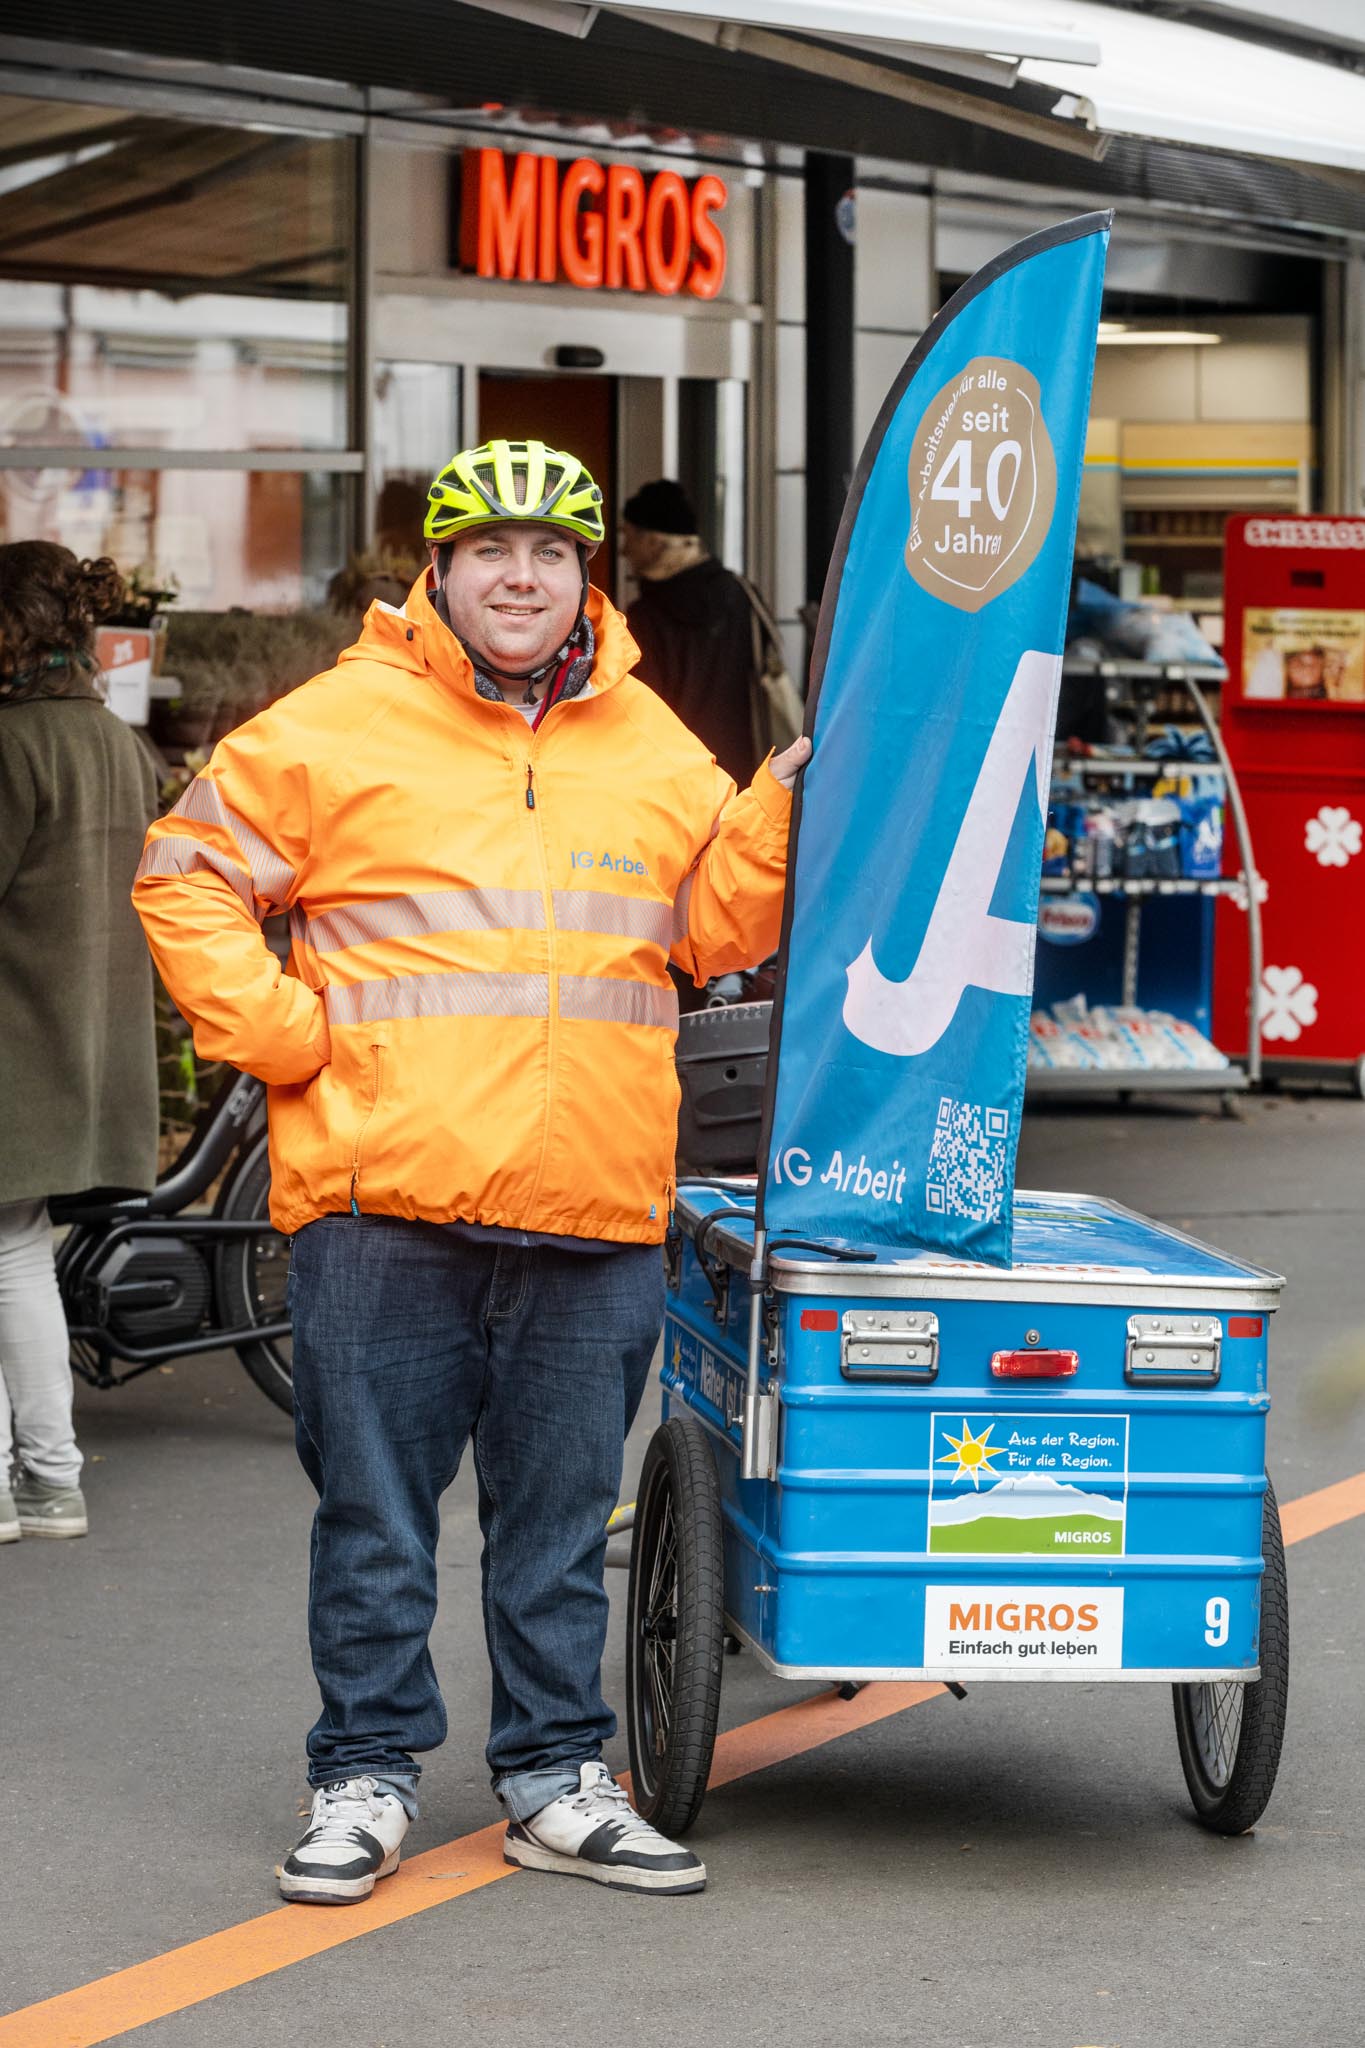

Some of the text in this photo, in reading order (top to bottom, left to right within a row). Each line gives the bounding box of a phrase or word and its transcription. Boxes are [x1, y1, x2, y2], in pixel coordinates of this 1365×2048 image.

[477, 147, 728, 299] MIGROS
[977, 369, 1007, 391] alle
[962, 403, 1009, 433] seit
[931, 439, 1022, 521] 40
[571, 851, 594, 869] IG
[774, 1147, 906, 1203] IG Arbeit
[1008, 1431, 1120, 1449] Aus der Region.
[1008, 1452, 1112, 1470] Für die Region.
[1054, 1531, 1112, 1544] MIGROS
[949, 1603, 1099, 1632] MIGROS
[1204, 1596, 1231, 1648] 9
[949, 1640, 1098, 1658] Einfach gut leben
